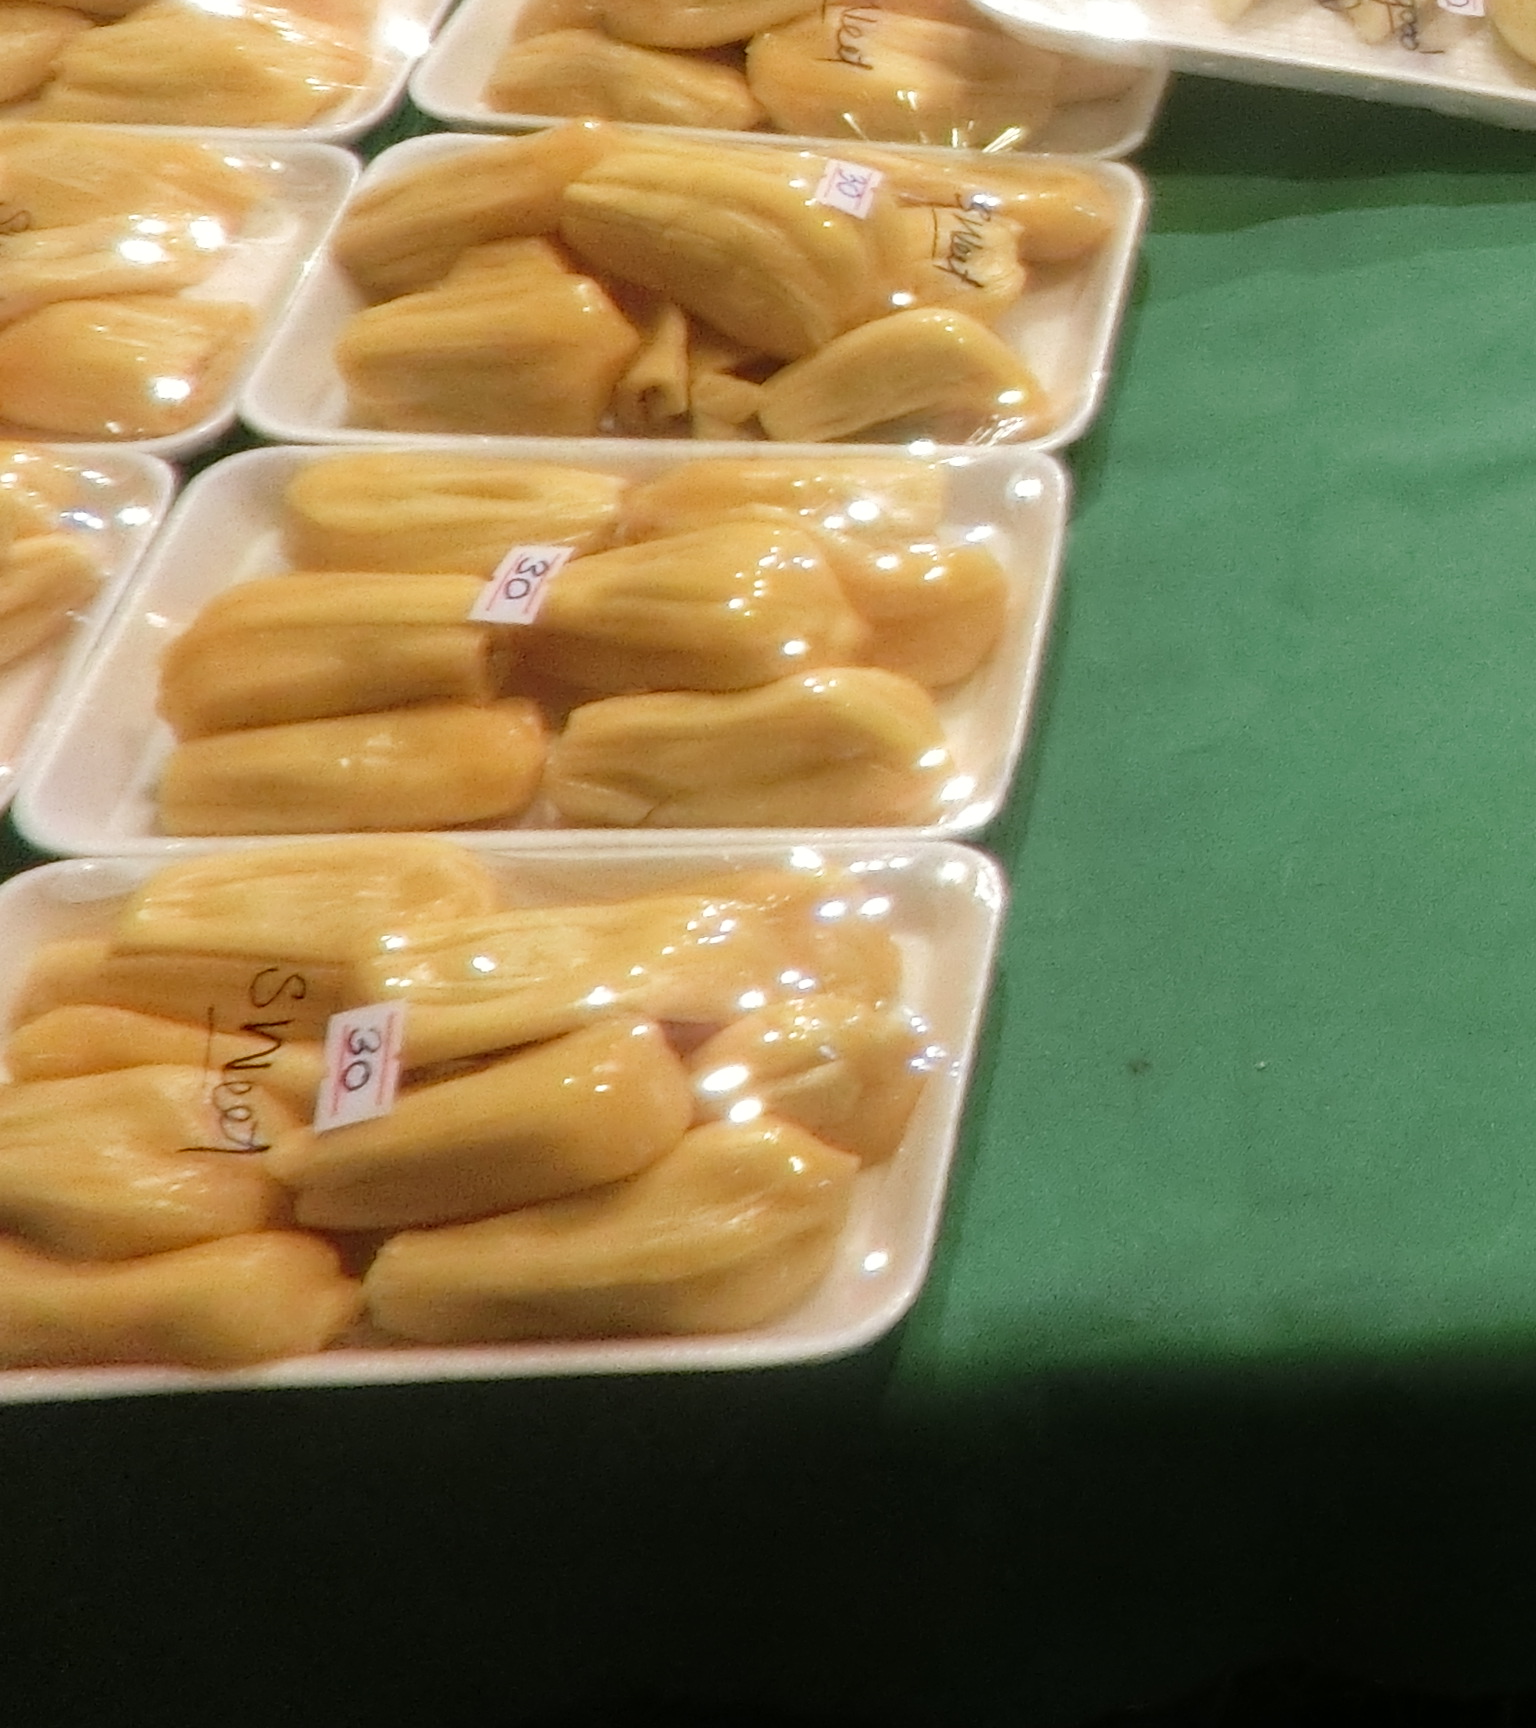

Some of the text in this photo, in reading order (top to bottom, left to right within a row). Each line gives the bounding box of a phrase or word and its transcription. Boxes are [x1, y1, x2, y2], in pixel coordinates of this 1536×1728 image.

[837, 167, 869, 200] 30
[504, 556, 549, 601] 30
[343, 1027, 382, 1092] 30
